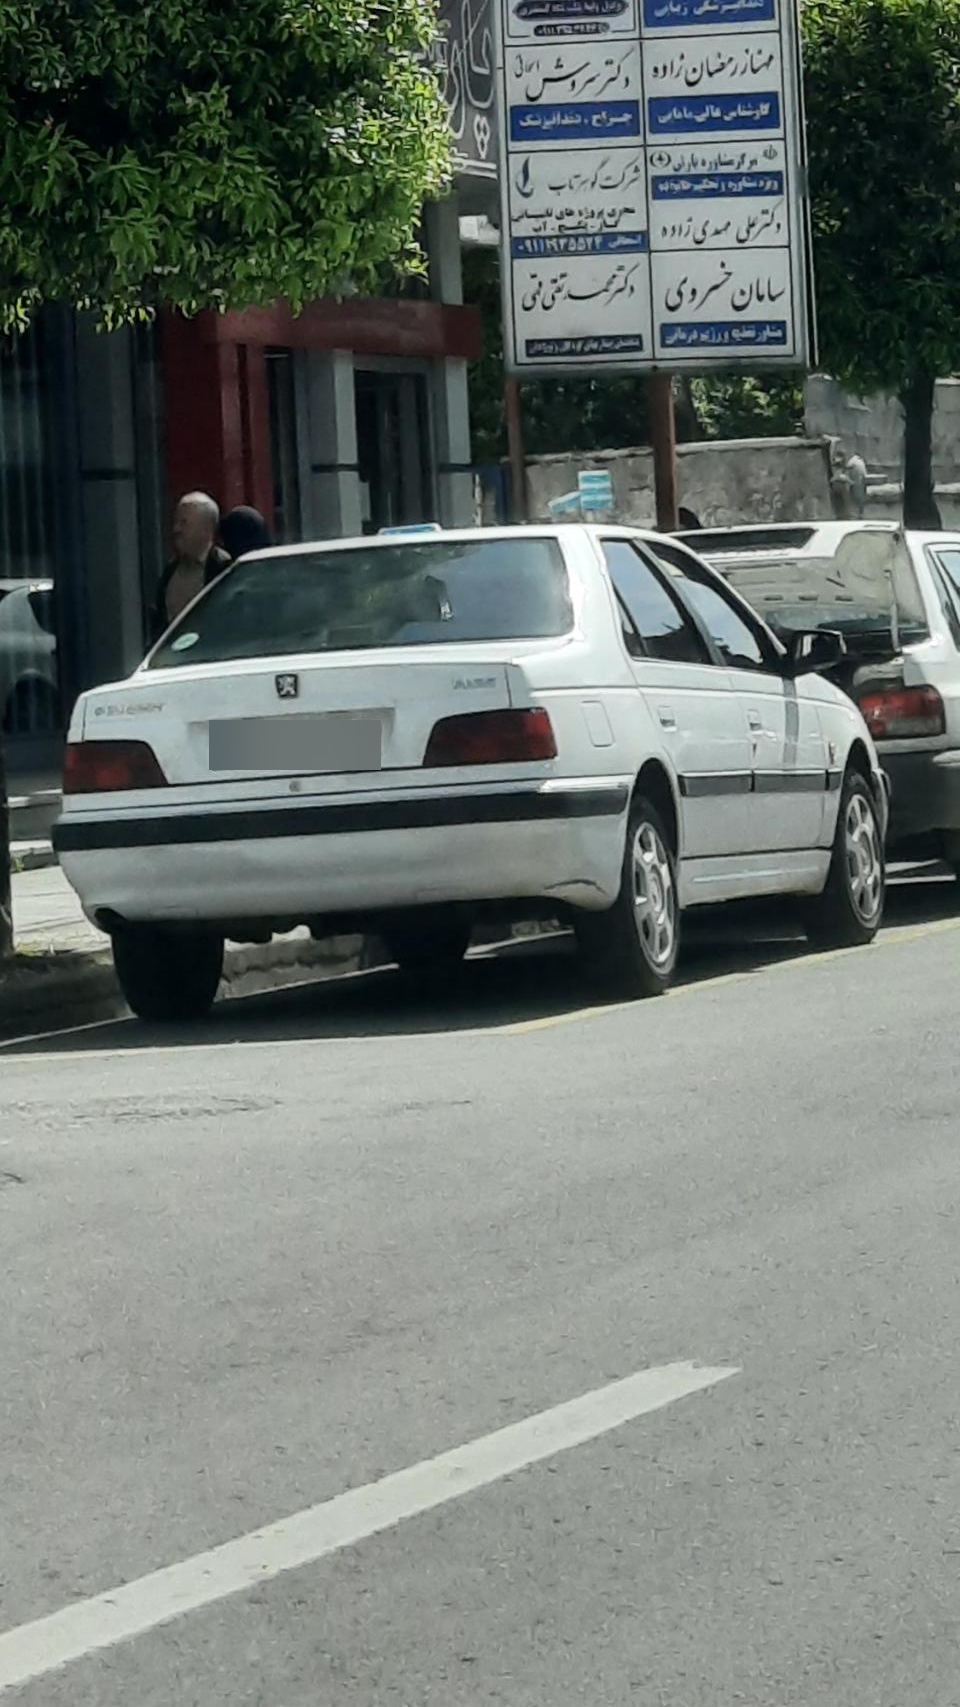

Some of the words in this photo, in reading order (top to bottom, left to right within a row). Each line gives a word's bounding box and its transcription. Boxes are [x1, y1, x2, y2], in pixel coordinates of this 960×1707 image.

[593, 46, 636, 98] دکتر
[651, 52, 686, 79] زاده
[684, 52, 739, 88] رمضان
[740, 47, 775, 76] مهناز
[749, 196, 785, 243] دکتر
[603, 262, 640, 307] دکتر
[664, 260, 734, 313] خسروی
[730, 276, 786, 313] سامان
